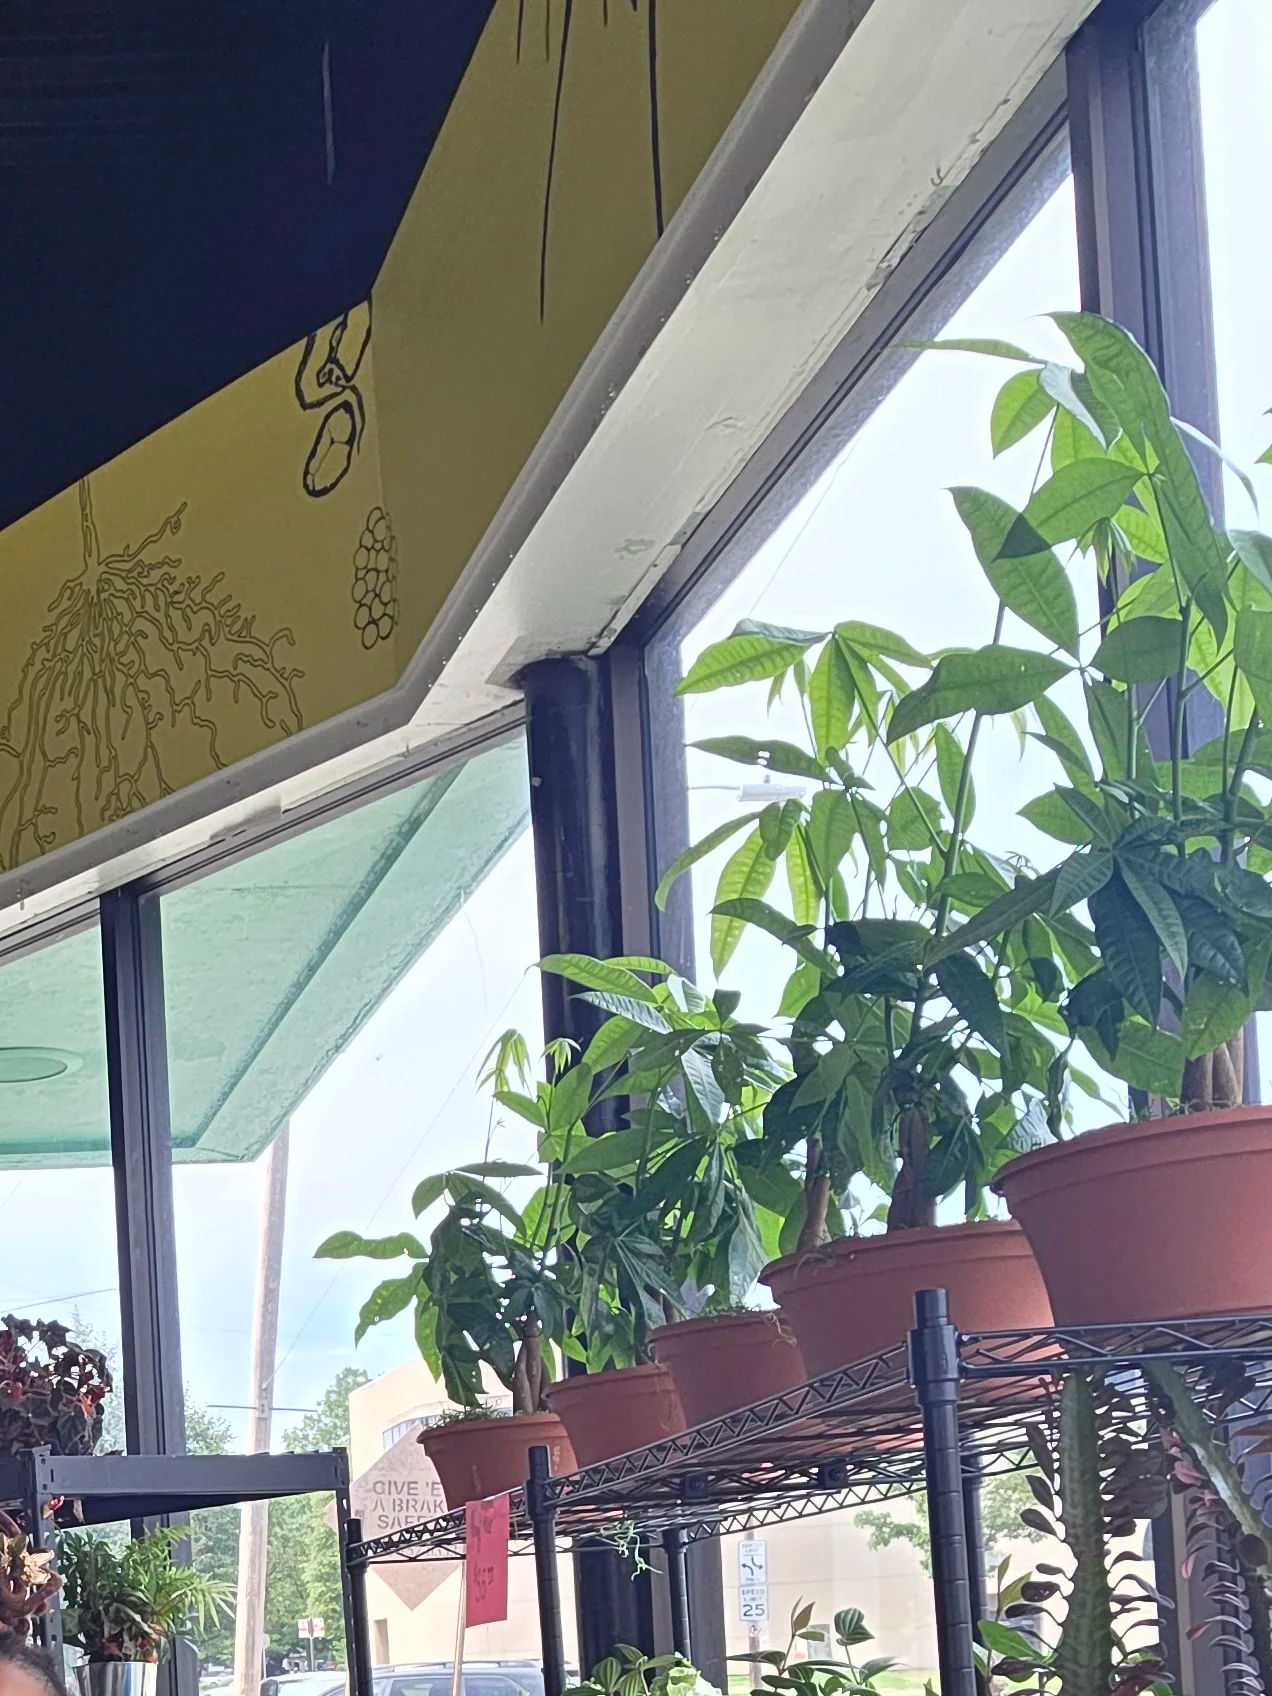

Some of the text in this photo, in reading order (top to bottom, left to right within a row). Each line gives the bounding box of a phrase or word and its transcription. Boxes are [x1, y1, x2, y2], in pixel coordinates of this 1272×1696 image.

[372, 1480, 418, 1497] GIVE
[372, 1498, 385, 1513] A
[742, 1603, 765, 1617] 25
